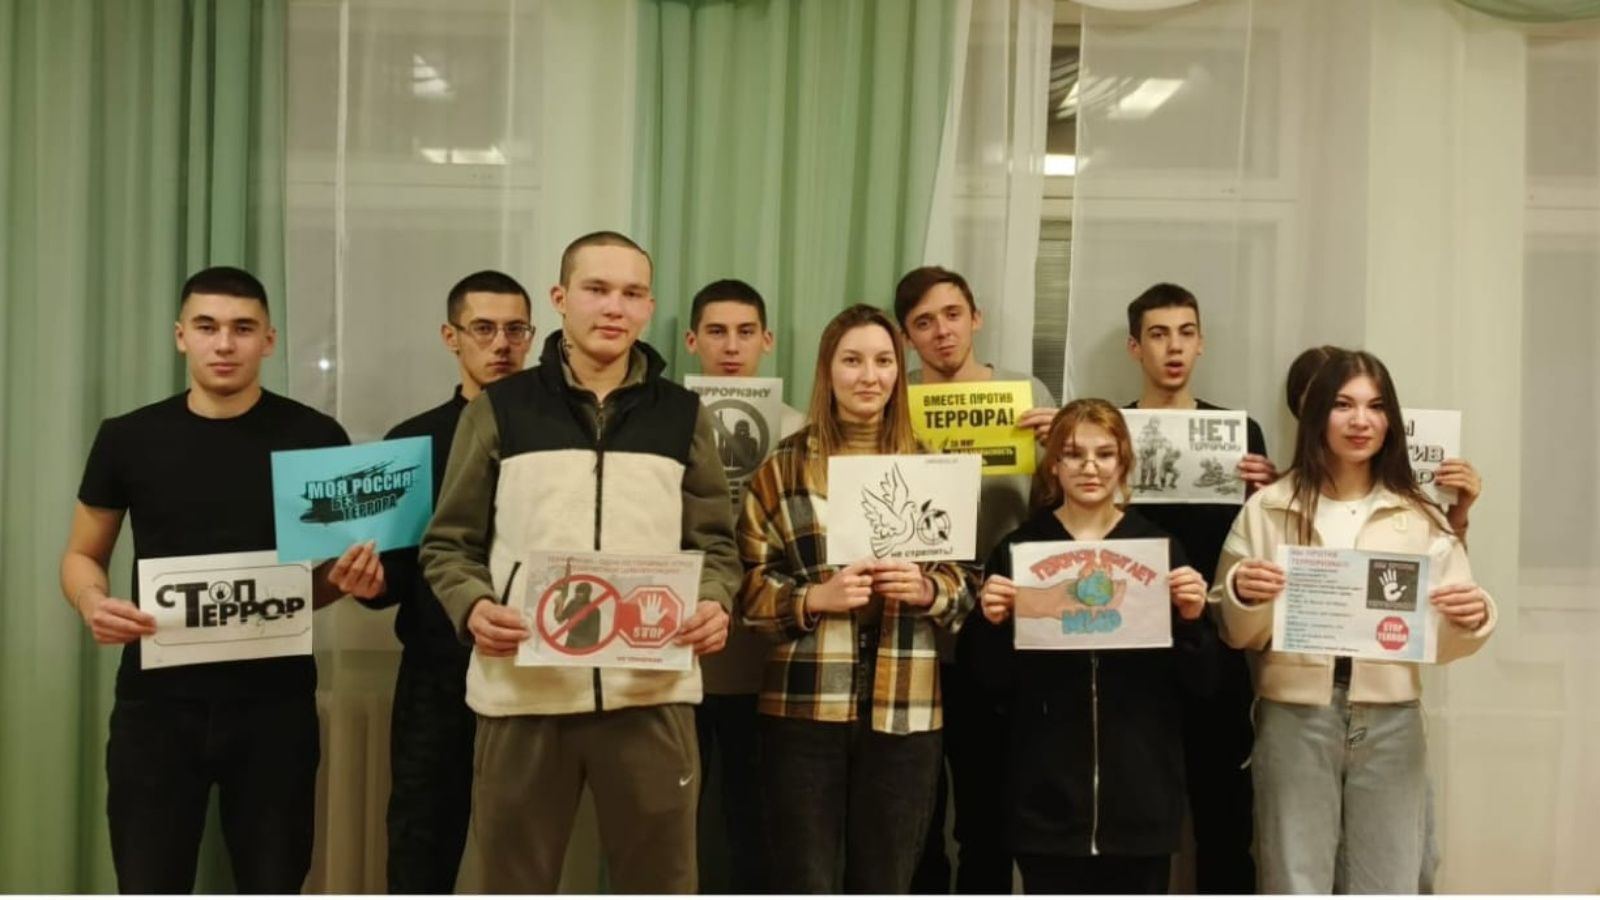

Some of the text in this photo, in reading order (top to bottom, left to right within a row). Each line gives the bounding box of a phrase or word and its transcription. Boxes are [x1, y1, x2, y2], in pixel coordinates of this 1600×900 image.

[923, 392, 1013, 406] ВМЕСТЕ ПРОТИВ
[924, 408, 1015, 428] ТЕРРОРА!
[1188, 418, 1240, 442] НЕТ
[307, 479, 348, 500] МОЯ
[632, 626, 665, 639] STOP
